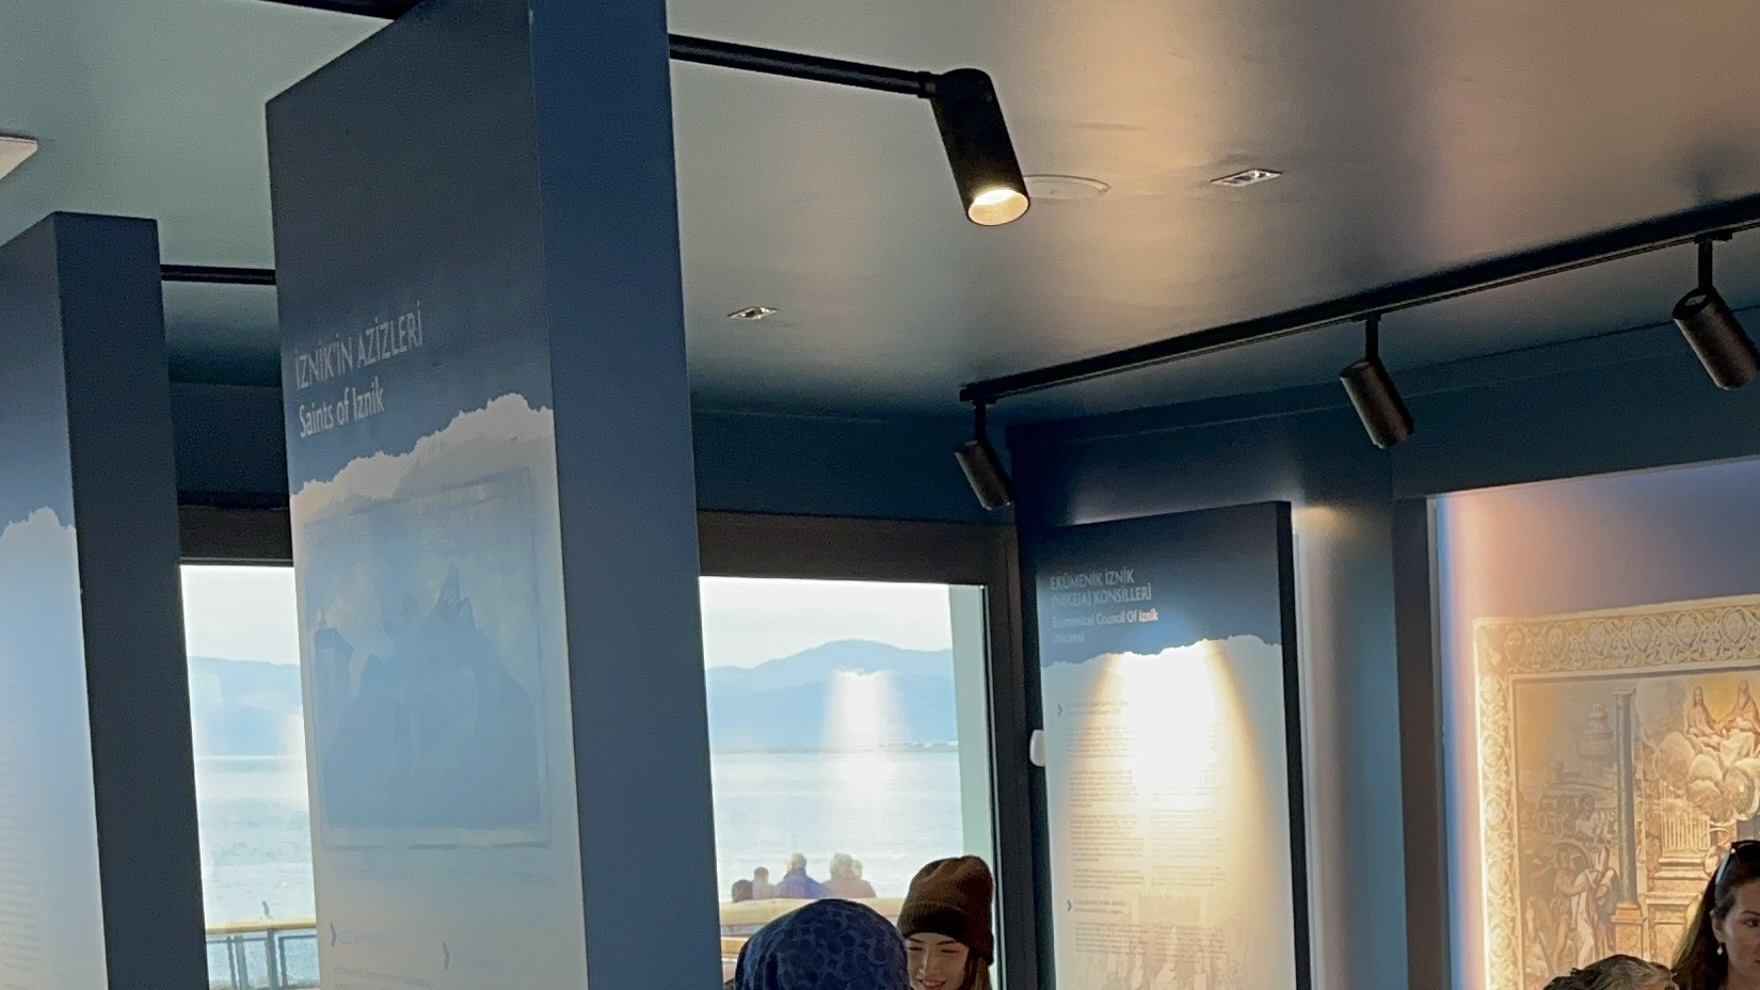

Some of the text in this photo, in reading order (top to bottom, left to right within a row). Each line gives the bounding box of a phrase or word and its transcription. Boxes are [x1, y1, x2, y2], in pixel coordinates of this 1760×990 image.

[357, 300, 422, 369] AZİZLERİ
[299, 376, 384, 438] Saints of Iznik
[1096, 610, 1126, 625] Council
[1126, 609, 1138, 623] Of
